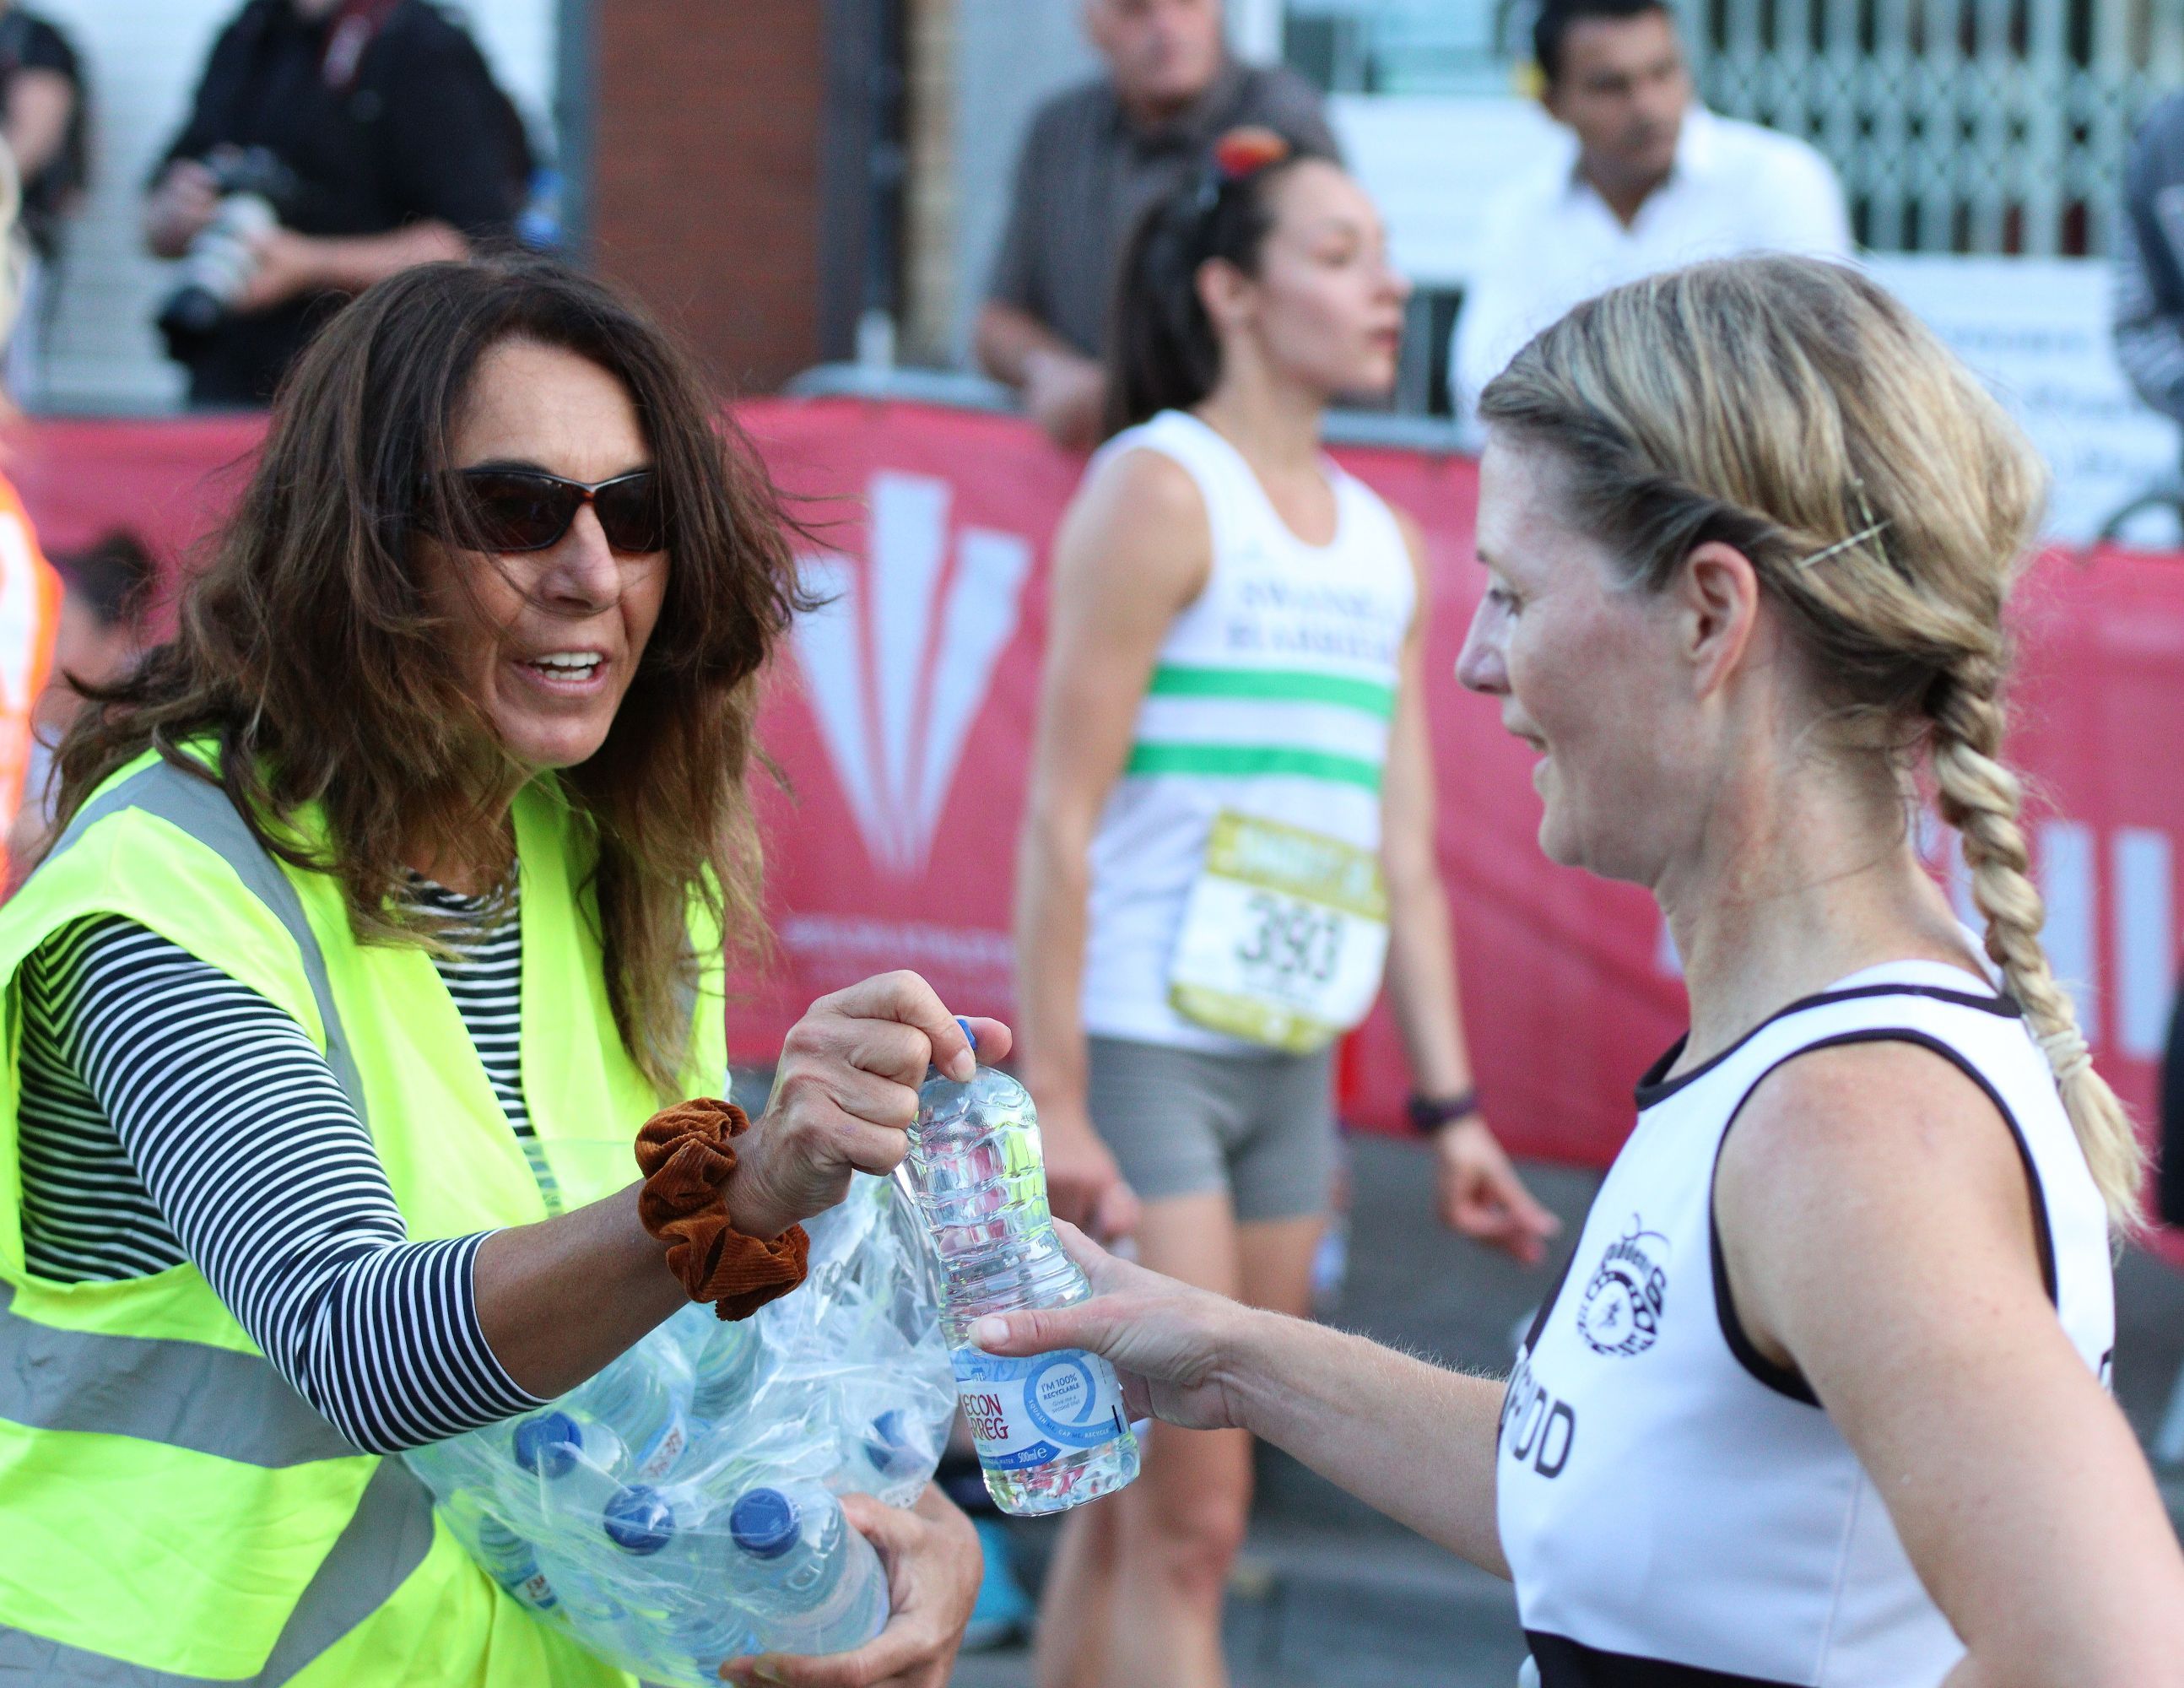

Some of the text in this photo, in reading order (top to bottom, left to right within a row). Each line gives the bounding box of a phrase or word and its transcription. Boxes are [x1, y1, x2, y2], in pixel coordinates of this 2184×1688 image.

[1041, 1372, 1078, 1393] I'M 100%
[1043, 1382, 1080, 1401] RECYCLABLE
[1029, 1399, 1047, 1425] SQUASH
[1084, 1428, 1110, 1438] RECYCLE
